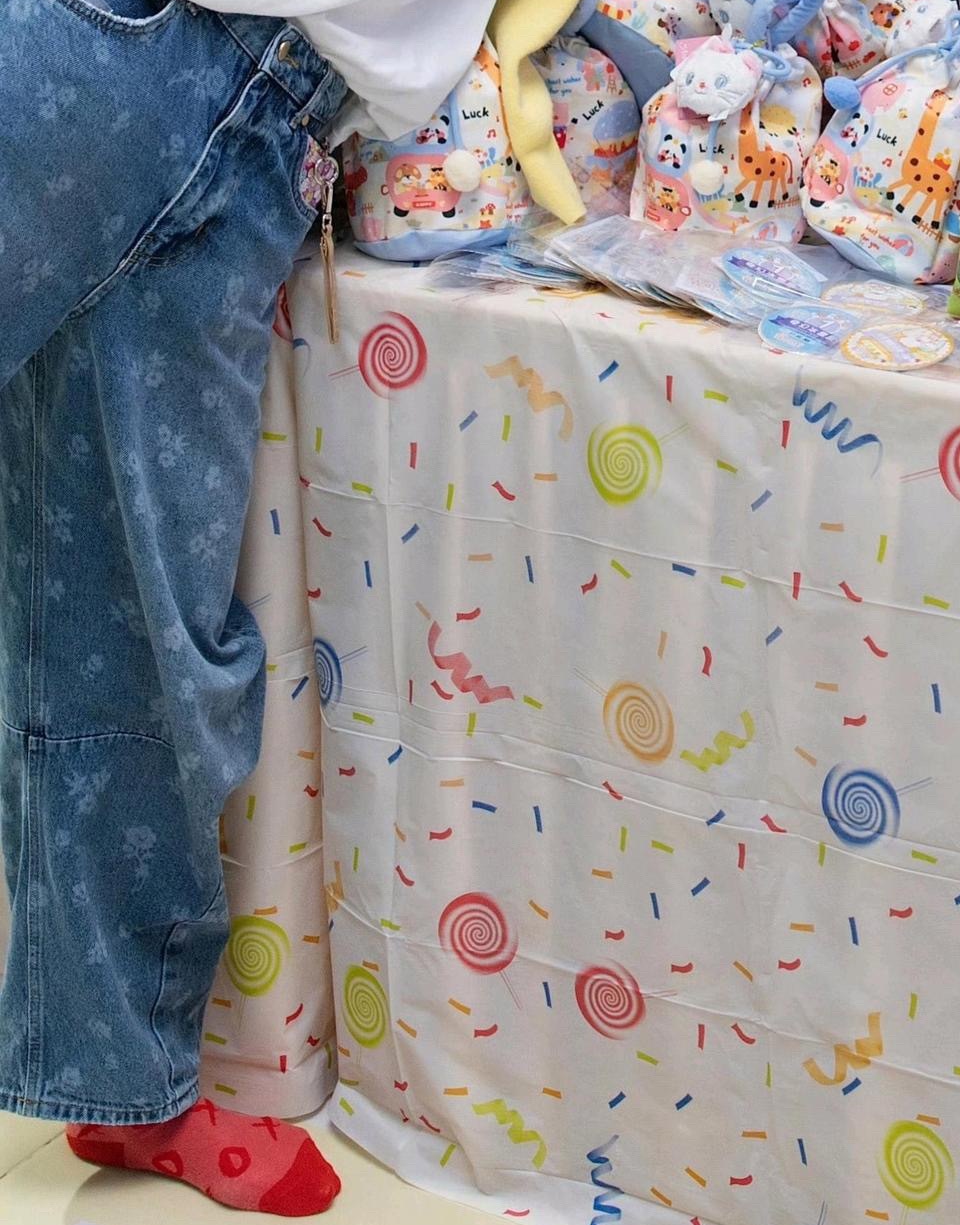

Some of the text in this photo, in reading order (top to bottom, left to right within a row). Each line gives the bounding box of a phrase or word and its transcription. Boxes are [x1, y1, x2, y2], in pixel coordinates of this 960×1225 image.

[462, 107, 490, 120] Luck
[582, 99, 605, 121] Luck
[876, 128, 898, 147] Luck
[699, 143, 725, 155] Lck
